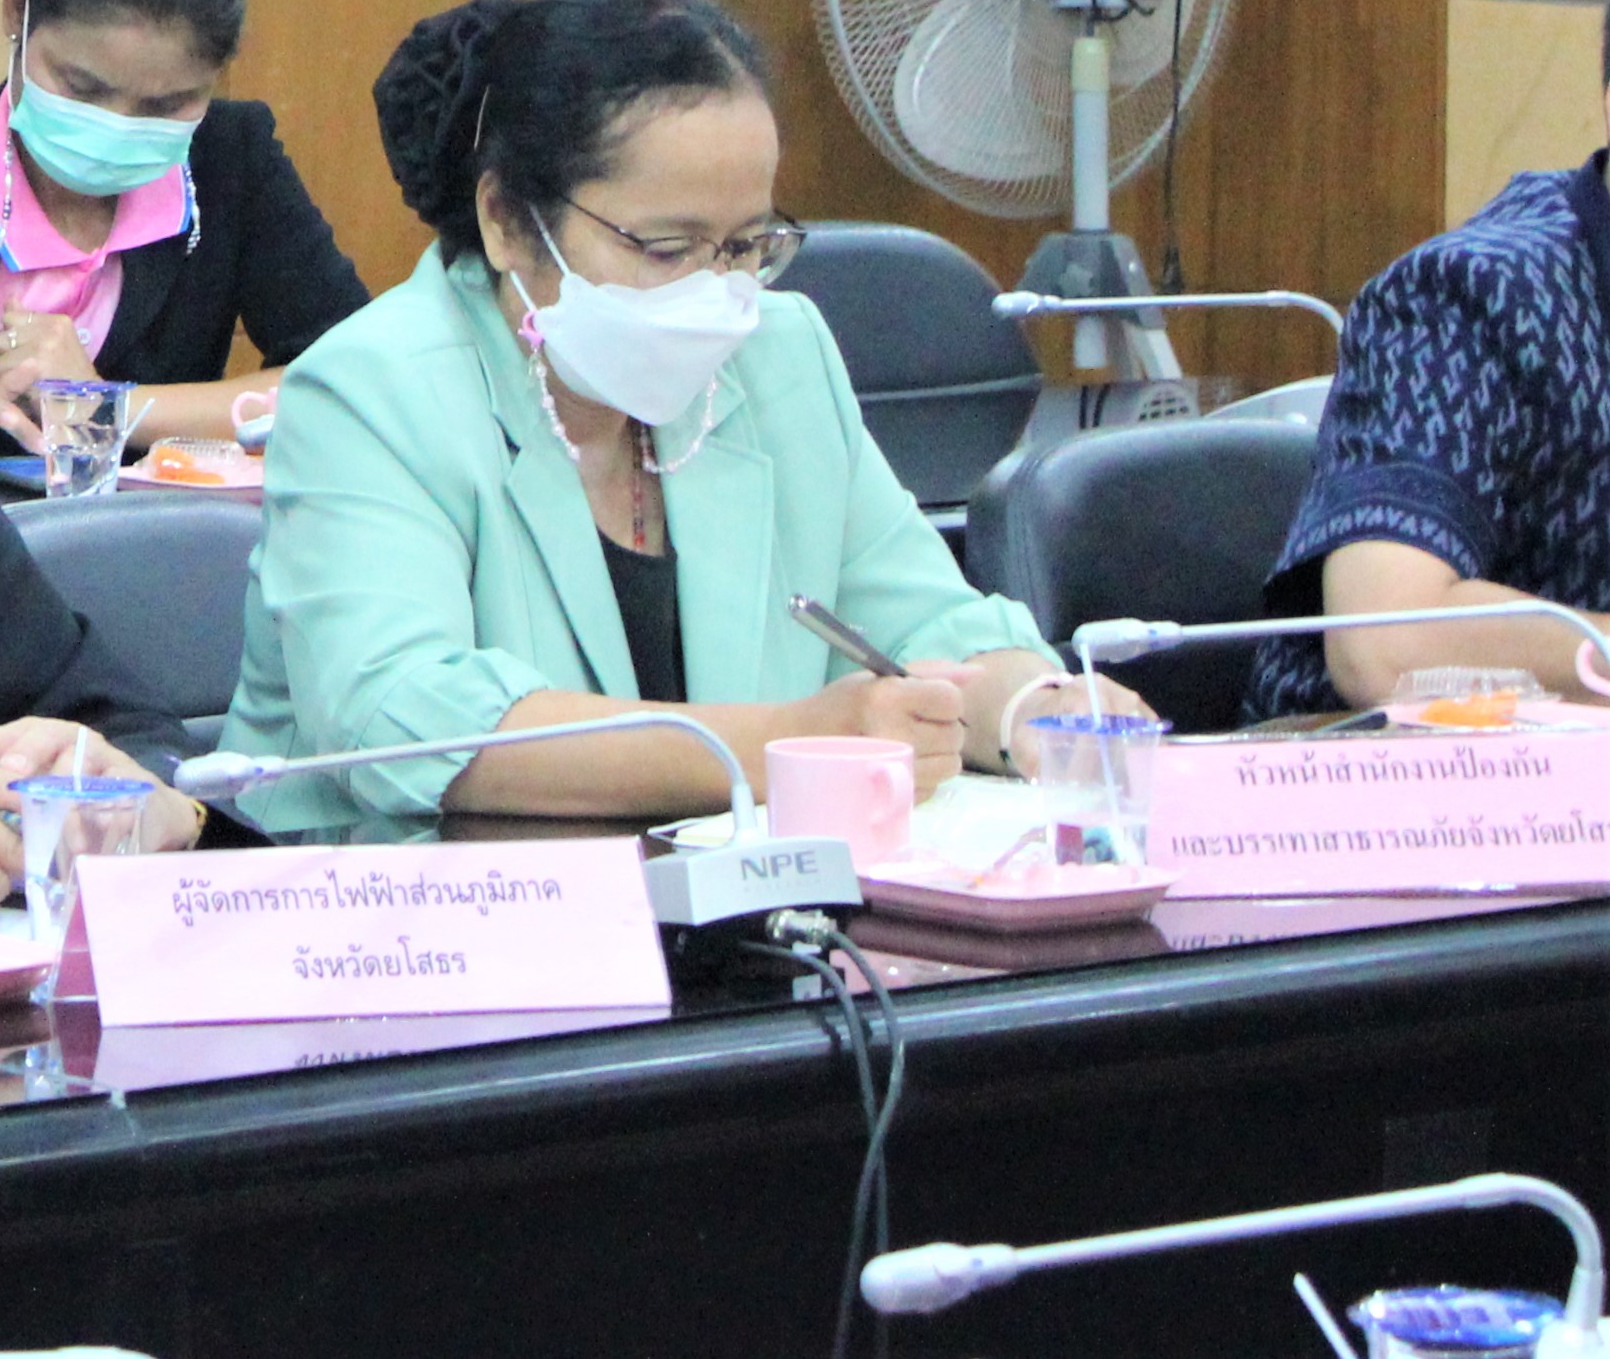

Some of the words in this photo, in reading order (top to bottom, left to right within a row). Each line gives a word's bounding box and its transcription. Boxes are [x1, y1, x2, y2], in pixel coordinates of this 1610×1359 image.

[1234, 745, 1552, 788] หัวหน้าสำนักงานป้องกัน
[1171, 809, 1610, 858] และบรรเทาสาธารณภัยจังหวัดยโส
[740, 849, 819, 881] NPE
[172, 869, 562, 928] ผู้จัดการการไฟฟ้าส่วนภูมิภาค
[292, 935, 467, 980] จังหวัดยโสธร
